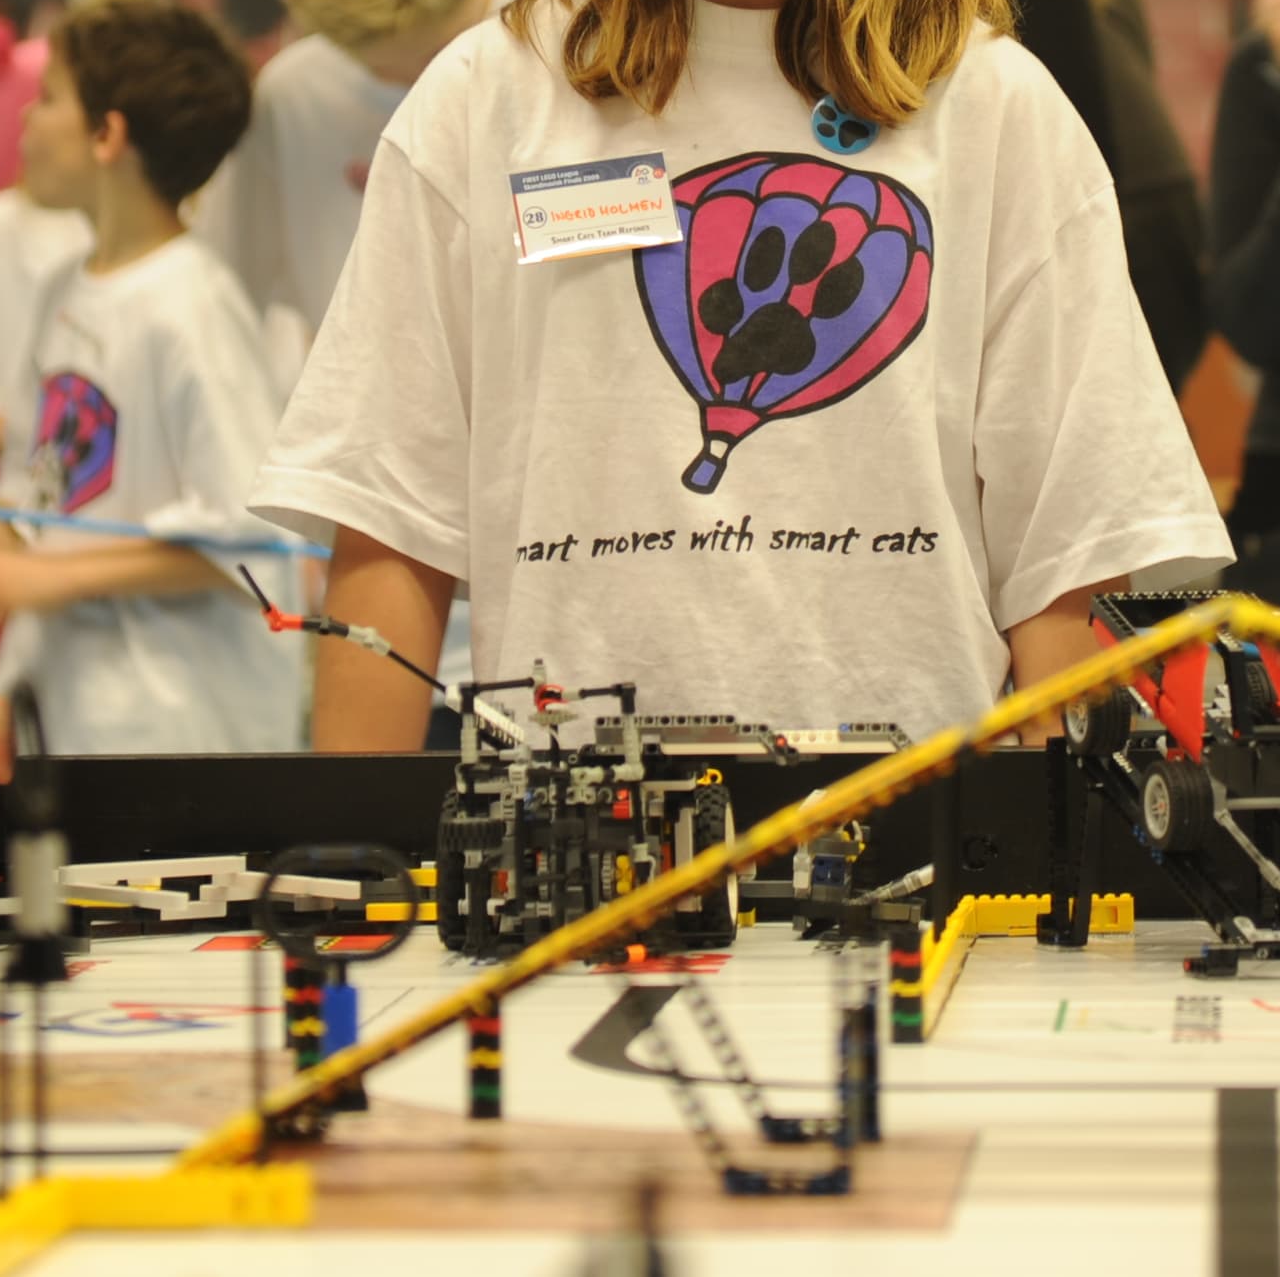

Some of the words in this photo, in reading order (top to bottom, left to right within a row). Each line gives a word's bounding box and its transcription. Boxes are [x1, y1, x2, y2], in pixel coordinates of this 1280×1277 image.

[525, 211, 544, 224] 28
[550, 206, 596, 223] INGRID
[599, 197, 663, 217] HOLMEN
[591, 529, 676, 559] moves
[690, 515, 755, 552] with
[769, 527, 861, 555] smart
[871, 526, 939, 555] cats
